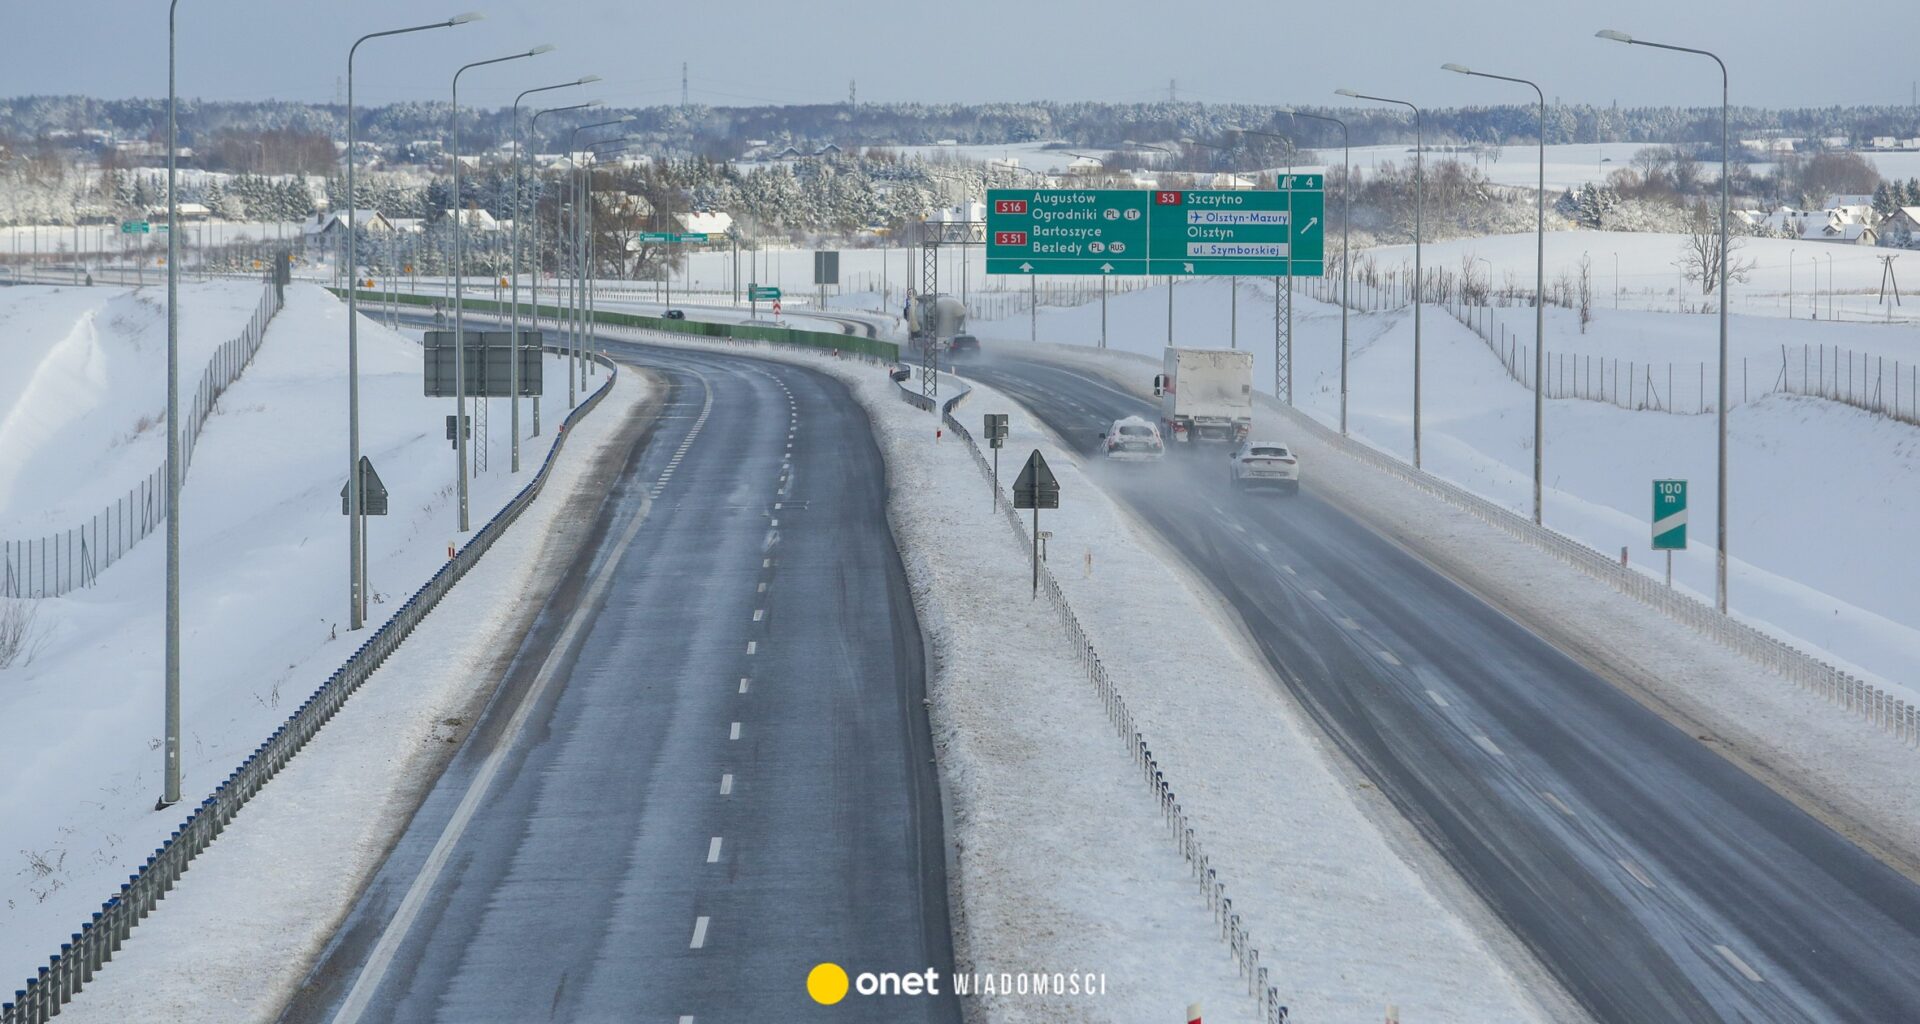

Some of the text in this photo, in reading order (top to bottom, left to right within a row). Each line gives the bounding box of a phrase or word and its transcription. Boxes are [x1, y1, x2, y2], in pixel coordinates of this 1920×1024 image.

[1305, 176, 1314, 188] 4
[1033, 192, 1096, 206] Augustów
[1161, 193, 1175, 204] 53
[1187, 193, 1243, 207] Szczytno
[1032, 208, 1097, 222] Ogrodniki
[1106, 210, 1117, 219] PL
[1127, 210, 1137, 219] LT
[1206, 212, 1288, 225] Olsztyn-Mazury
[1033, 225, 1102, 240] Bartoszyce
[1187, 226, 1234, 240] Olsztyn
[1033, 241, 1082, 256] Bezledy
[1091, 243, 1102, 252] PL
[1110, 243, 1124, 252] RUS
[1193, 245, 1280, 257] ul. Szymborskiej
[1659, 483, 1682, 494] 100
[1664, 495, 1676, 503] m
